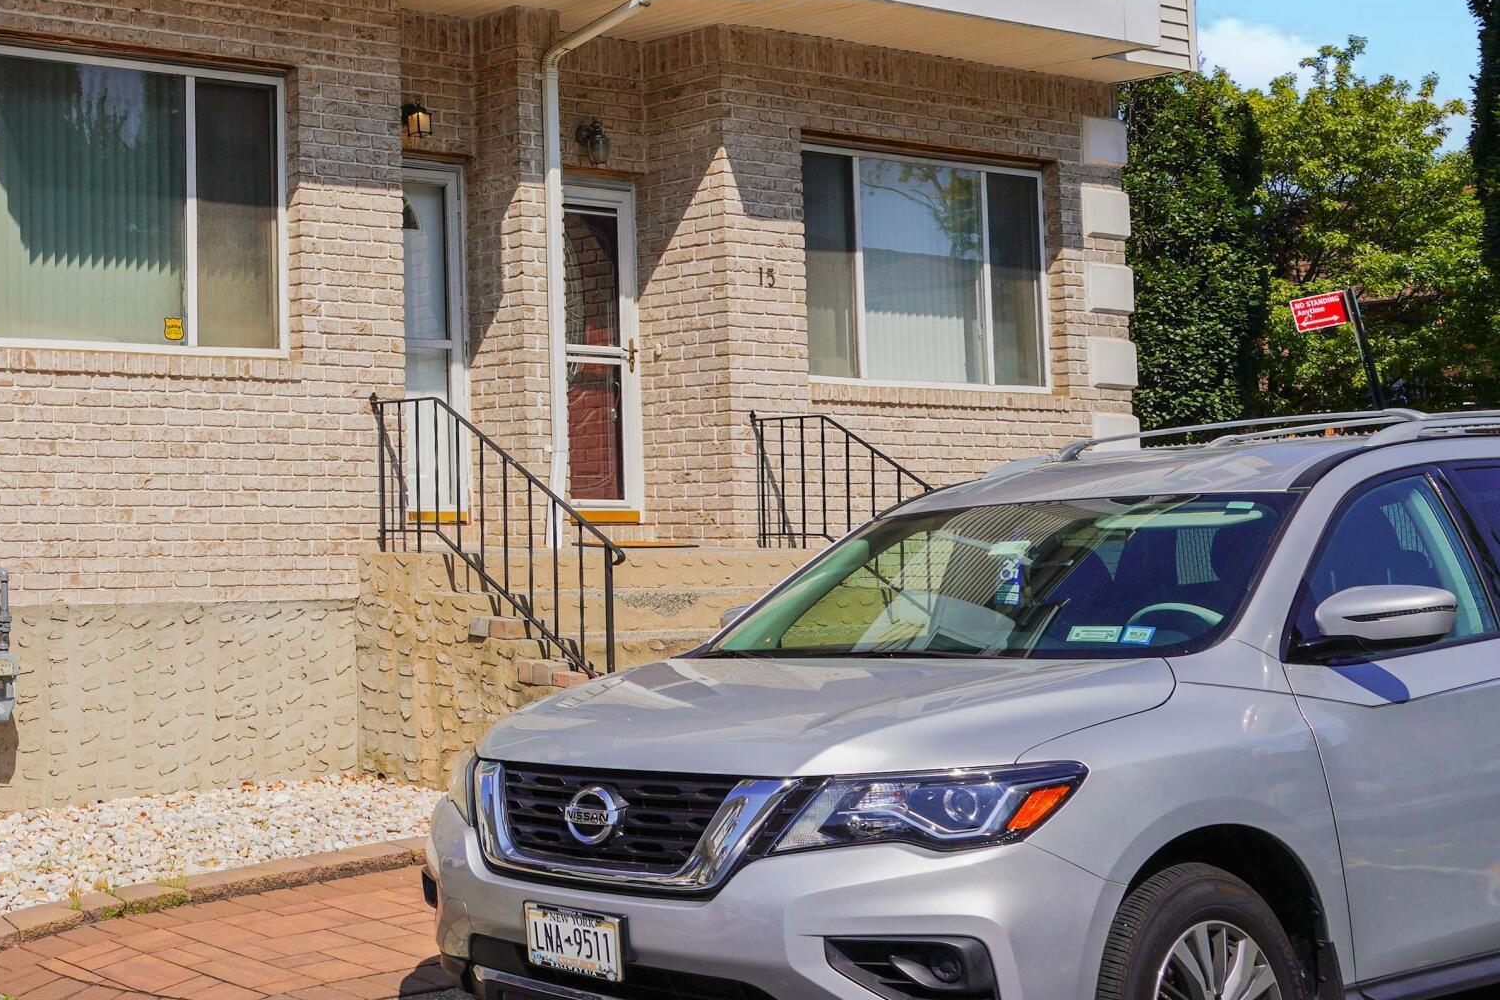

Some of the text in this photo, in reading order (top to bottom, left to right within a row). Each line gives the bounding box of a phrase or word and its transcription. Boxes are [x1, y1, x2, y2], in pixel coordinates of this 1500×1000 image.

[758, 266, 776, 288] 15
[1294, 295, 1340, 310] NO STANDING
[1297, 306, 1326, 317] Anytime
[566, 810, 609, 822] NISSAN
[548, 911, 597, 929] NEW YORK
[550, 961, 583, 974] RACEWAY
[584, 968, 598, 977] KIA
